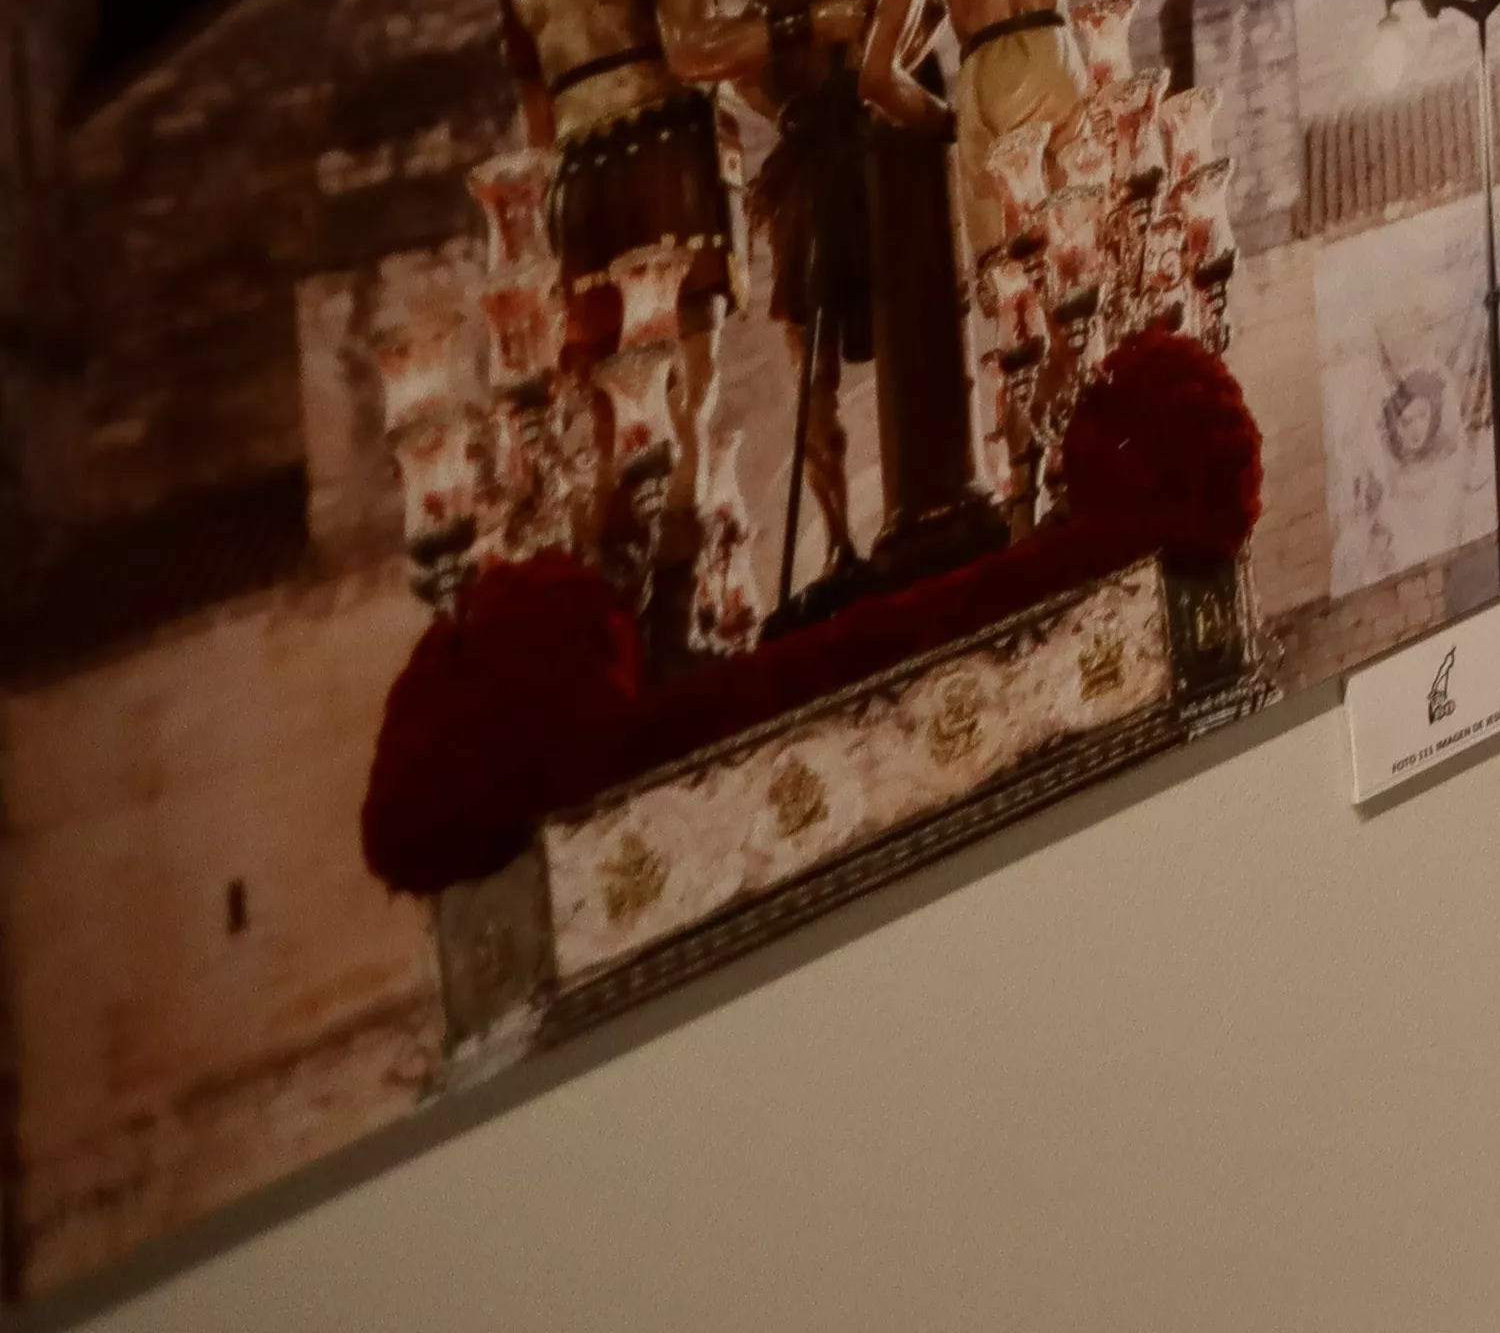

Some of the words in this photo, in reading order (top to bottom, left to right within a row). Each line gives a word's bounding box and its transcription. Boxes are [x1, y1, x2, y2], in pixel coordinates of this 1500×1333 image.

[1392, 756, 1417, 774] FOTO
[1436, 724, 1471, 752] IMAGEN
[1472, 720, 1485, 734] DE
